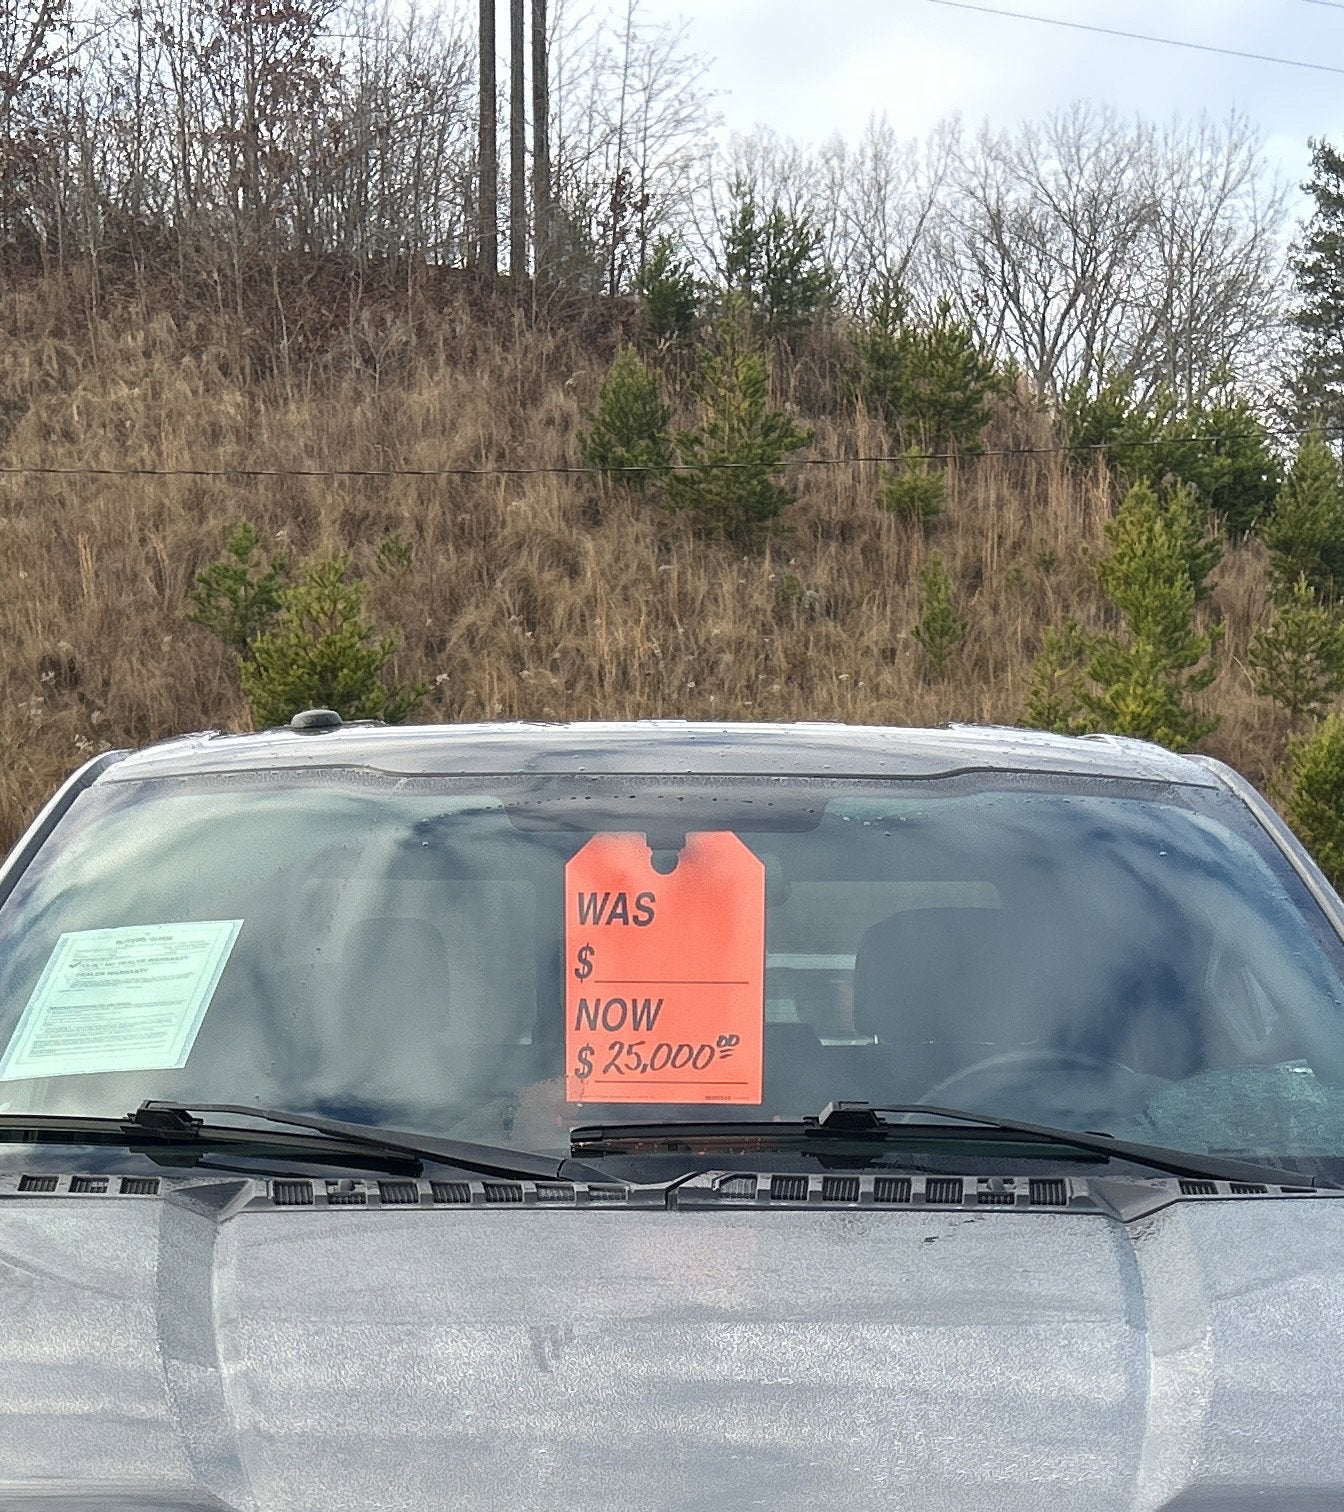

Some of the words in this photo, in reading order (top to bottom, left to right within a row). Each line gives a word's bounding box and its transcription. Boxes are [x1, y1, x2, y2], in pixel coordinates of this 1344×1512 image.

[577, 891, 656, 927] WAS
[574, 942, 595, 984] $
[574, 998, 665, 1032] NOW
[574, 1042, 595, 1084] $
